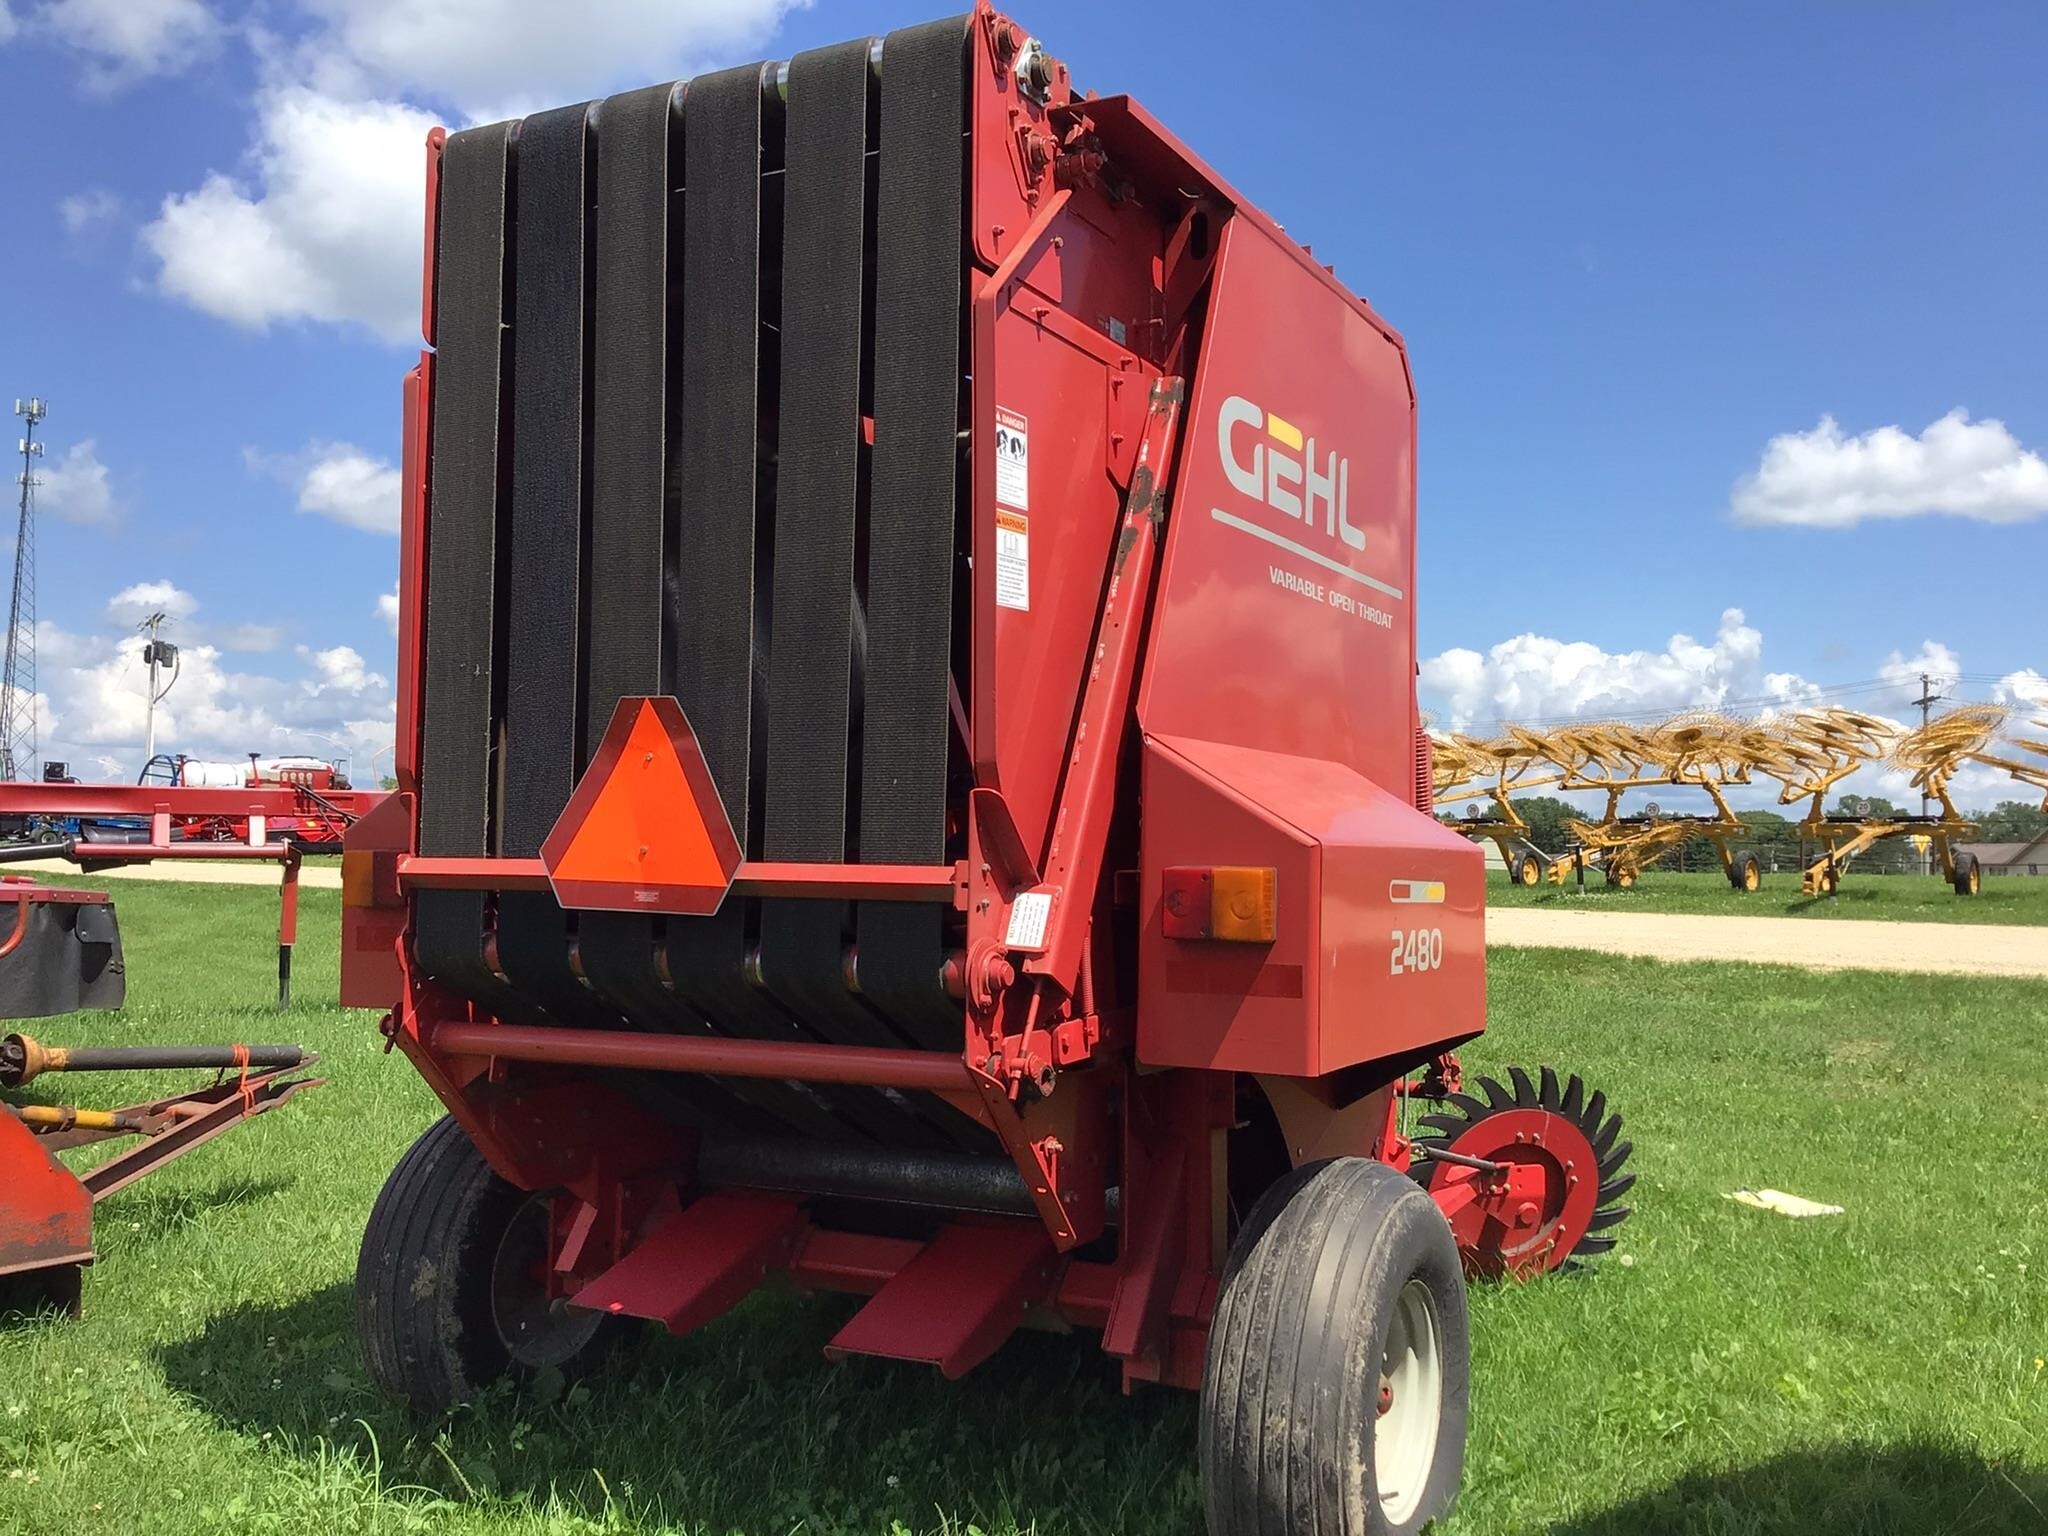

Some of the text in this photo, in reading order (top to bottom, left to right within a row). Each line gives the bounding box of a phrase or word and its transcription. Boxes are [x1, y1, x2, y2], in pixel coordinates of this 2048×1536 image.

[1218, 395, 1366, 551] GEHL
[1269, 565, 1393, 629] VARIABLE OPEN THROAT
[1391, 928, 1442, 975] 2480
